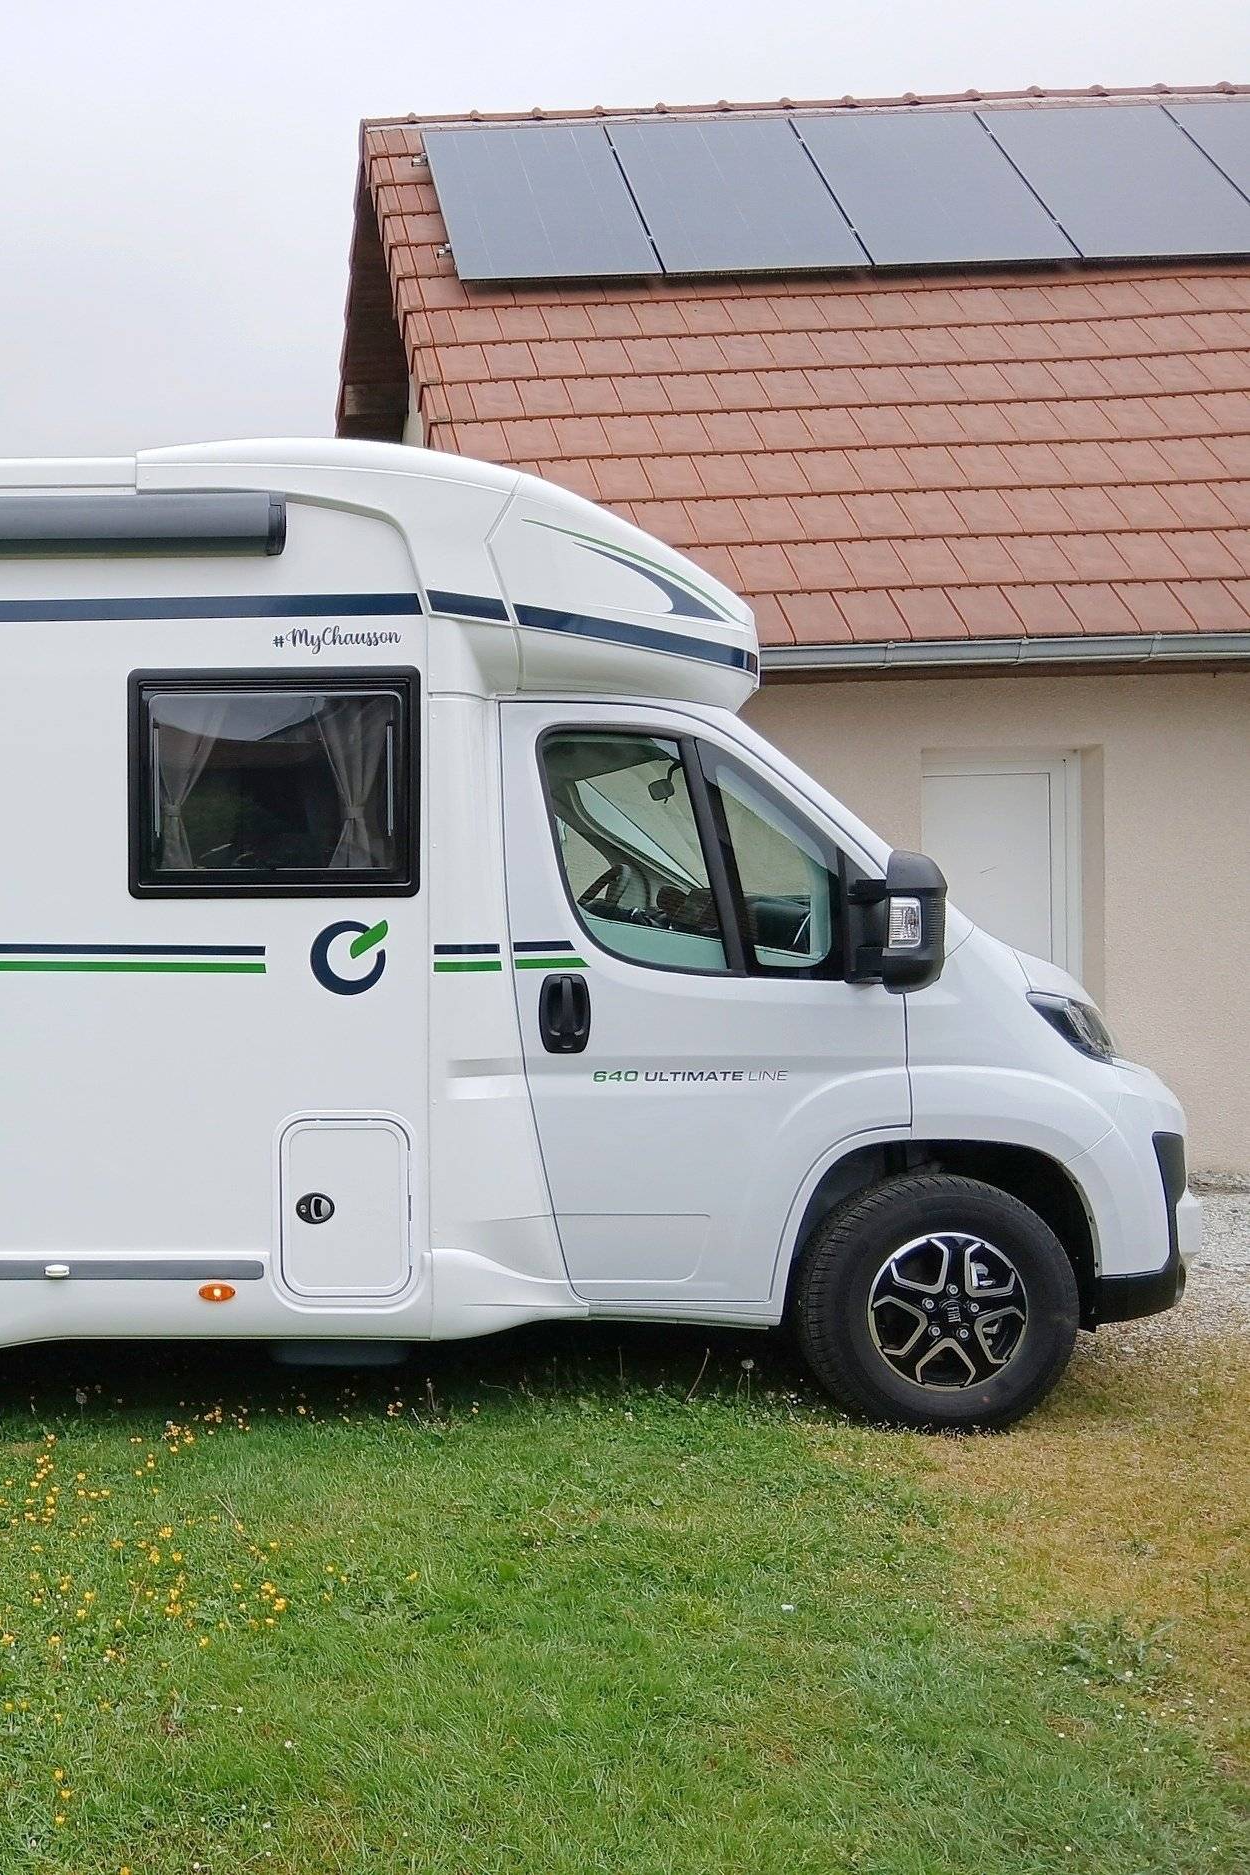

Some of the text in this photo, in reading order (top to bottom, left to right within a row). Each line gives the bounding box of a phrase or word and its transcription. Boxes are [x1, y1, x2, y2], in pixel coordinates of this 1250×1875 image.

[273, 625, 402, 655] #MyChausson
[593, 1070, 790, 1082] 640 ULTIMATE LINE
